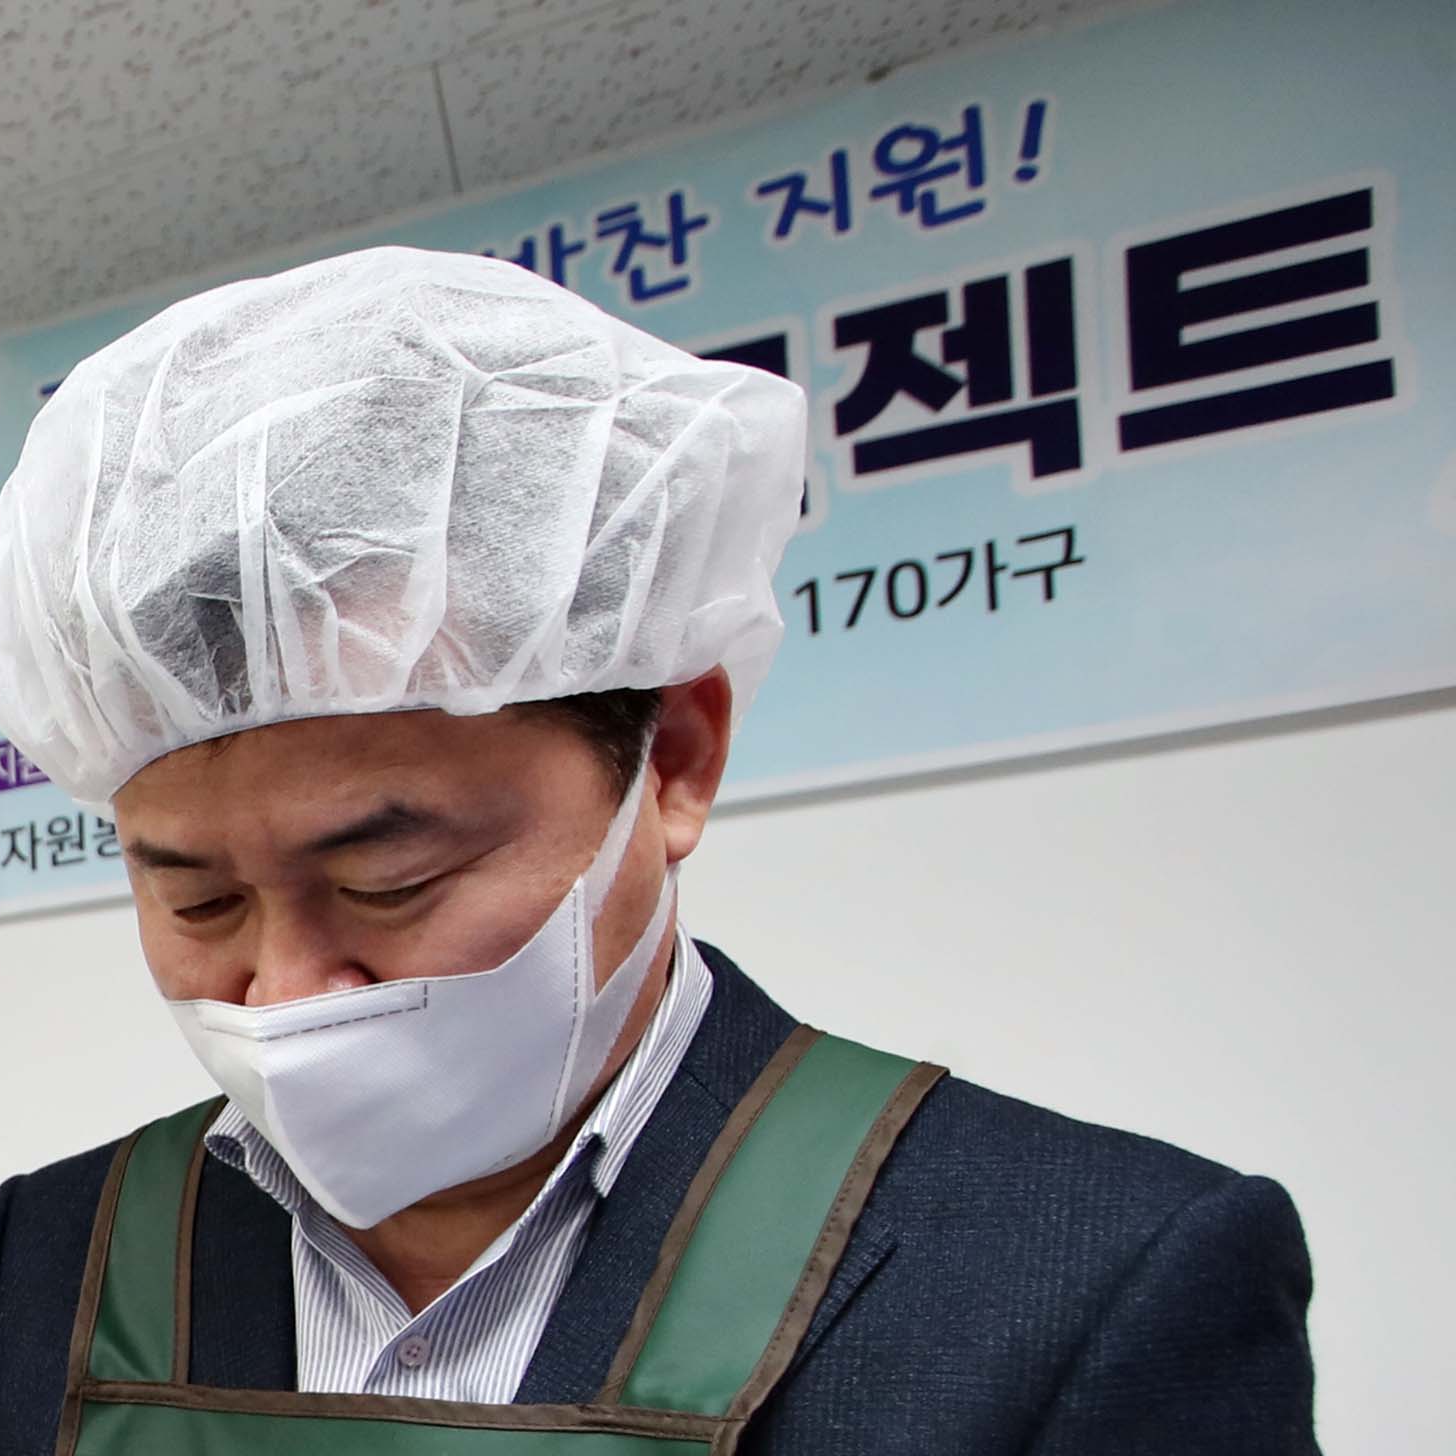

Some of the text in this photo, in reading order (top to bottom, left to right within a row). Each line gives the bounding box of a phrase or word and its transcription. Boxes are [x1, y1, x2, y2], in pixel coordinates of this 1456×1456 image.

[757, 100, 1049, 242] 지원!
[693, 187, 1395, 519] 젝트
[792, 526, 1087, 636] 170가구
